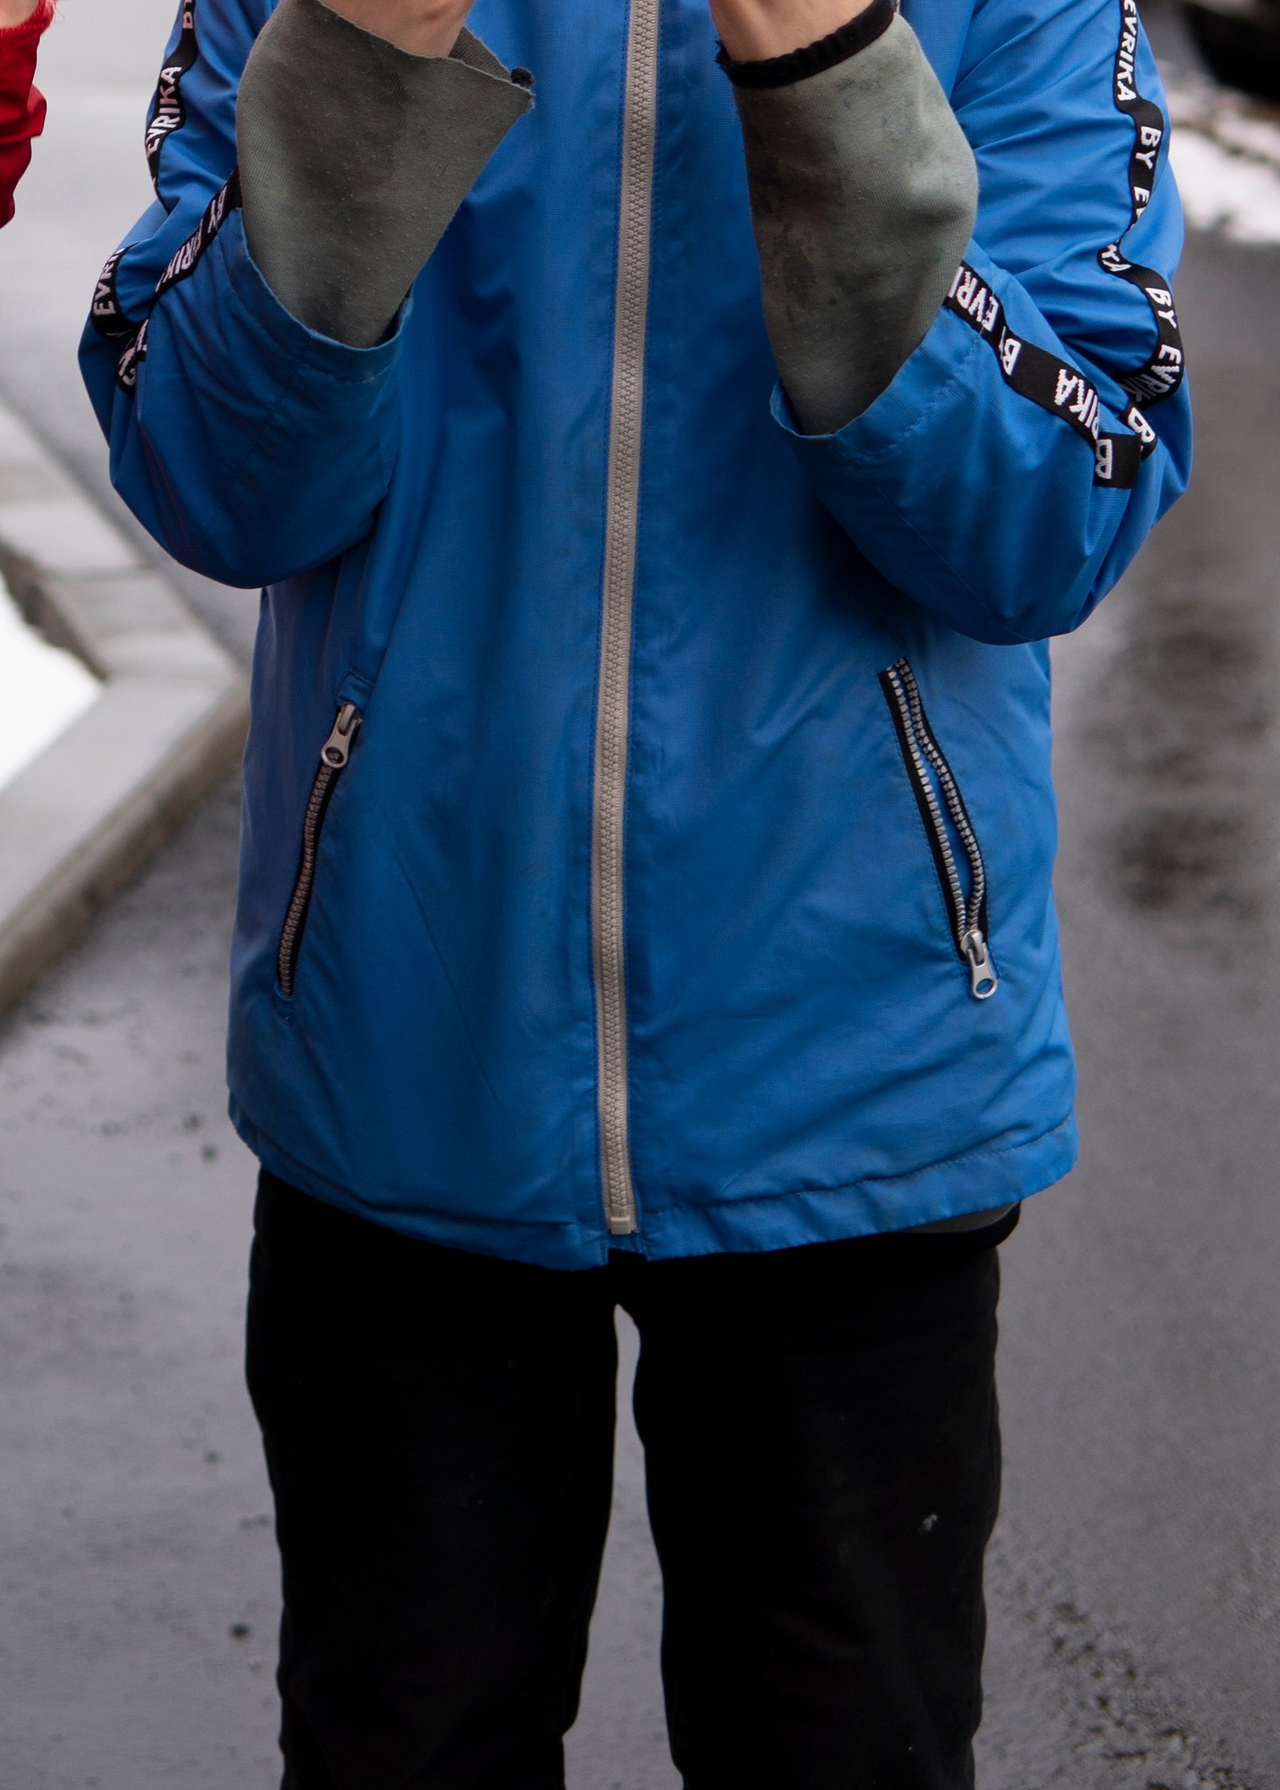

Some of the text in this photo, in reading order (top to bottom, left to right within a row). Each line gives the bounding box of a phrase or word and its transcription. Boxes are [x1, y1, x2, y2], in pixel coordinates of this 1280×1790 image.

[145, 66, 183, 159] EVRIKA
[1135, 125, 1163, 170] BY
[948, 265, 1000, 332] EVRI
[1145, 287, 1178, 330] BY
